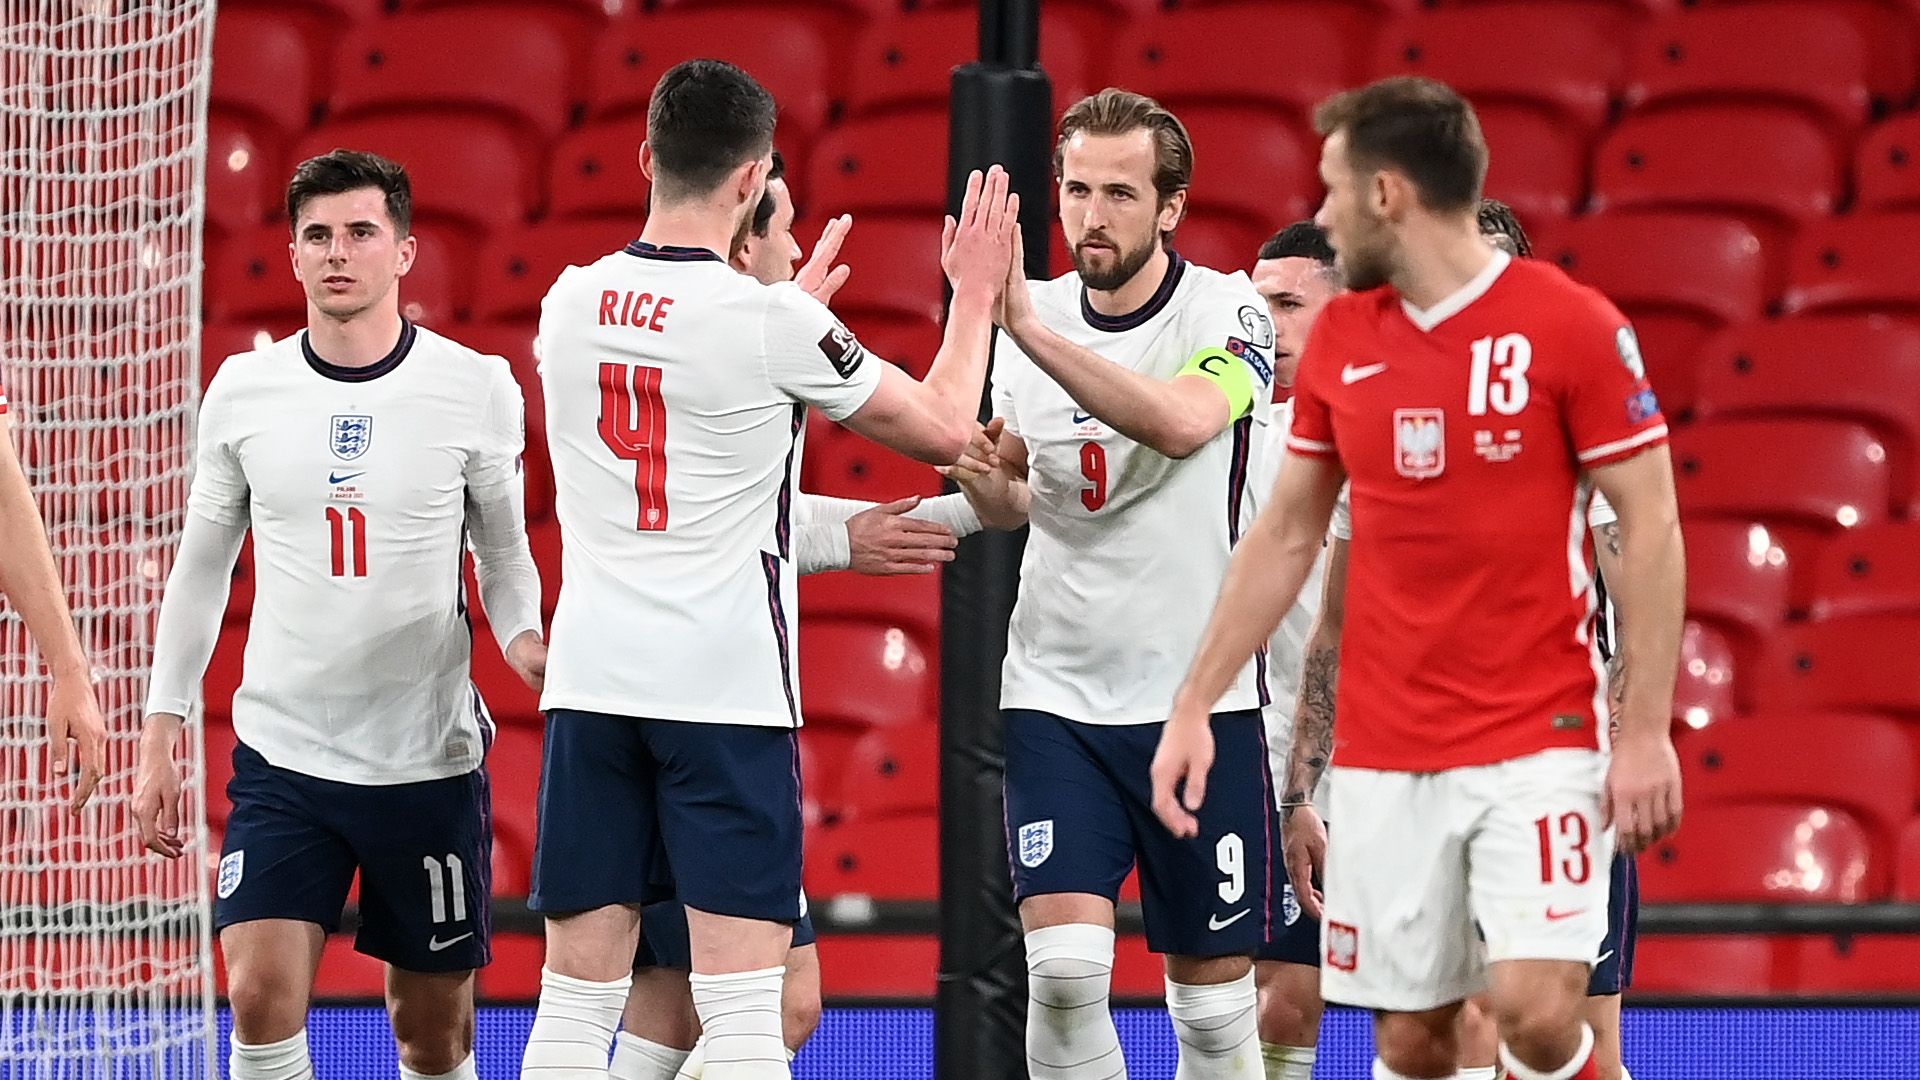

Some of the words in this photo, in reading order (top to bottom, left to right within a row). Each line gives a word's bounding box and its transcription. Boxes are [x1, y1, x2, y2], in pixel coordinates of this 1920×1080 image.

[599, 290, 674, 333] RICE
[1199, 355, 1229, 377] C
[1468, 332, 1532, 416] 13
[597, 362, 669, 532] 4
[1079, 440, 1107, 512] 9
[325, 506, 367, 577] 11
[1216, 832, 1245, 905] 9
[1534, 810, 1591, 886] 13
[423, 853, 467, 924] 11
